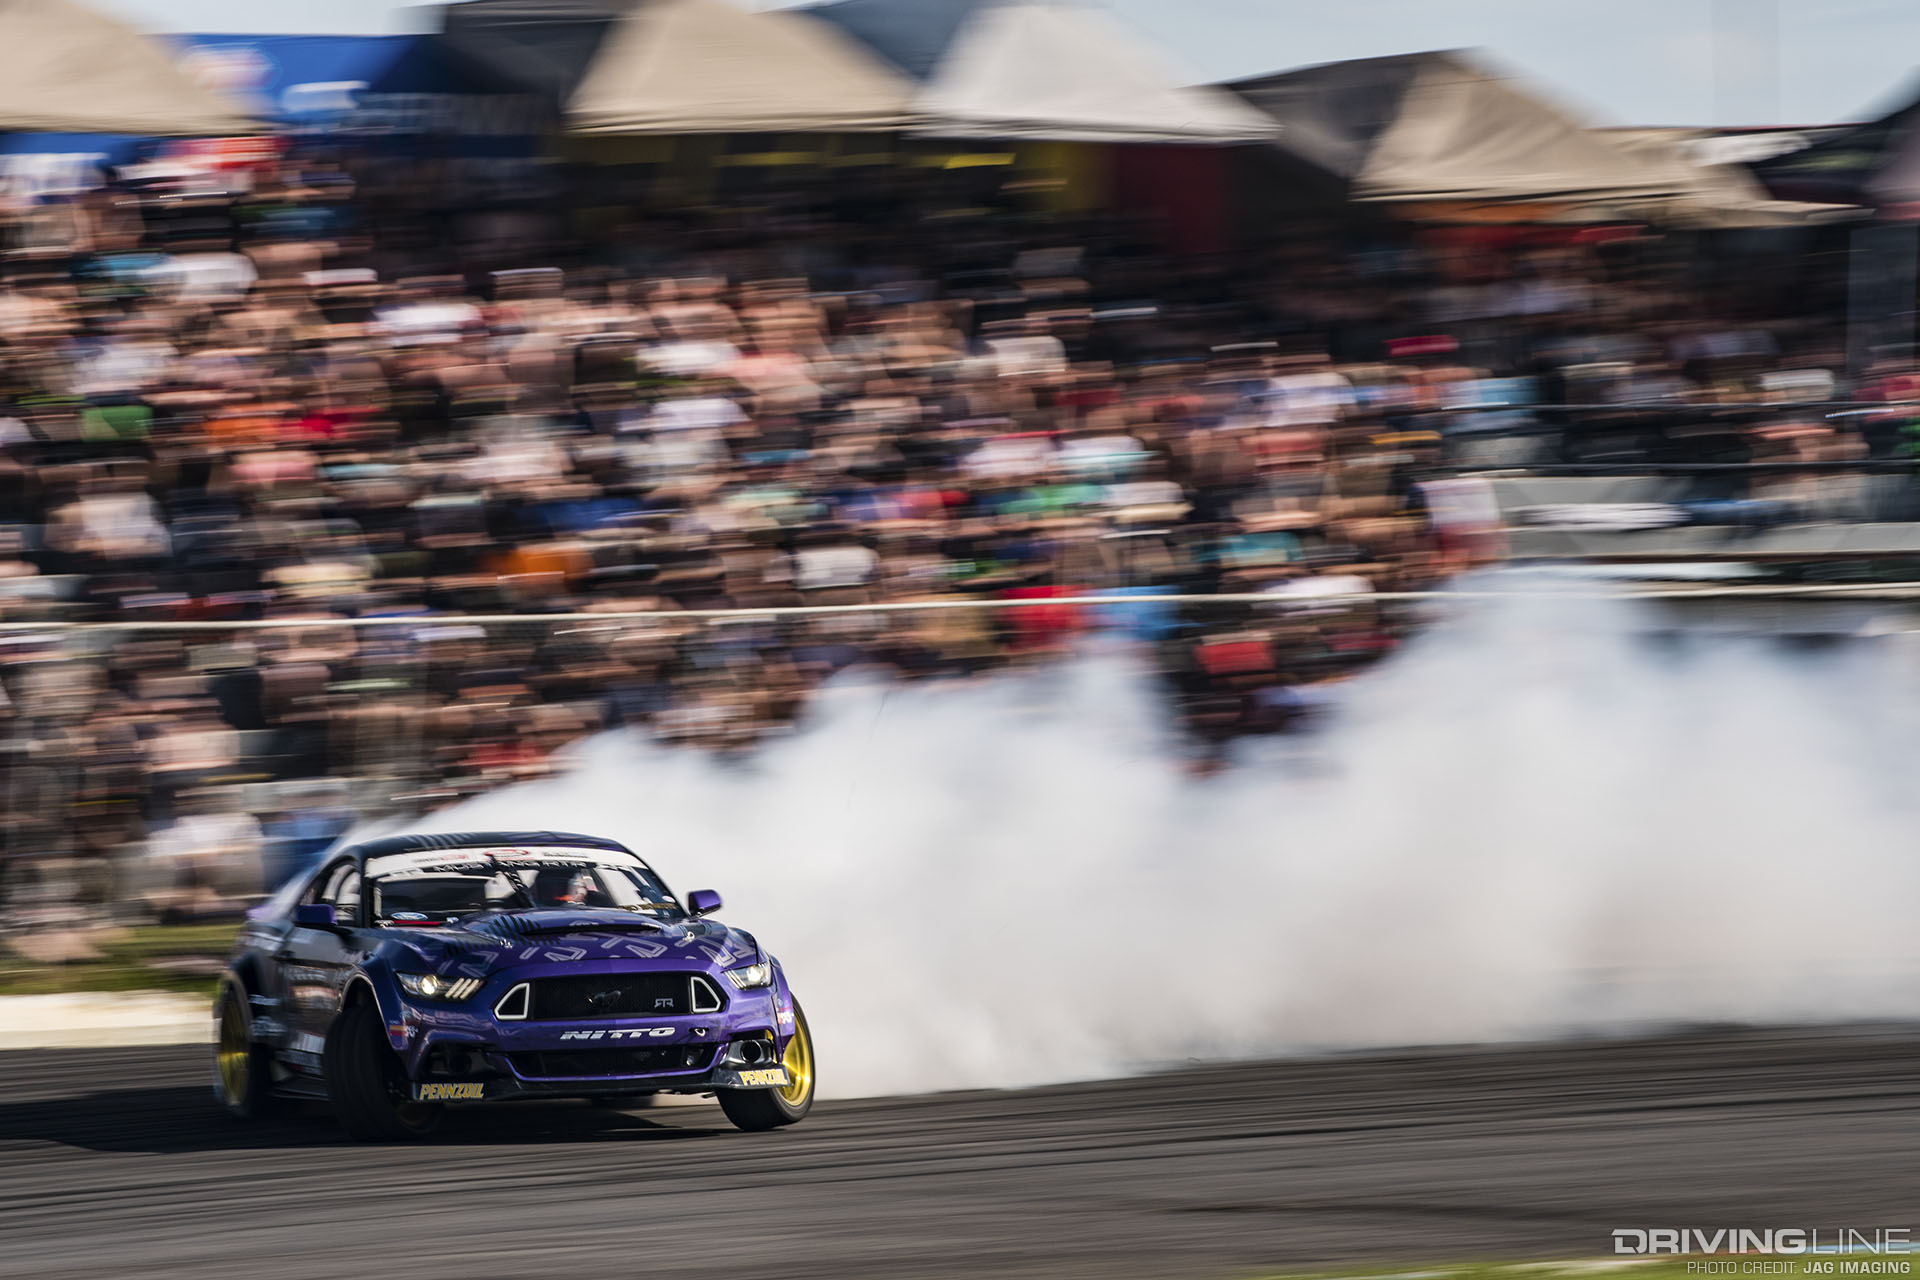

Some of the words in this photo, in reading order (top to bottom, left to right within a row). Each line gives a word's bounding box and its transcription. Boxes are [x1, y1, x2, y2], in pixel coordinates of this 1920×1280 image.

[559, 1027, 676, 1041] NITTO
[738, 1069, 788, 1086] PENNZOIL
[419, 1082, 484, 1101] PENNZOIL
